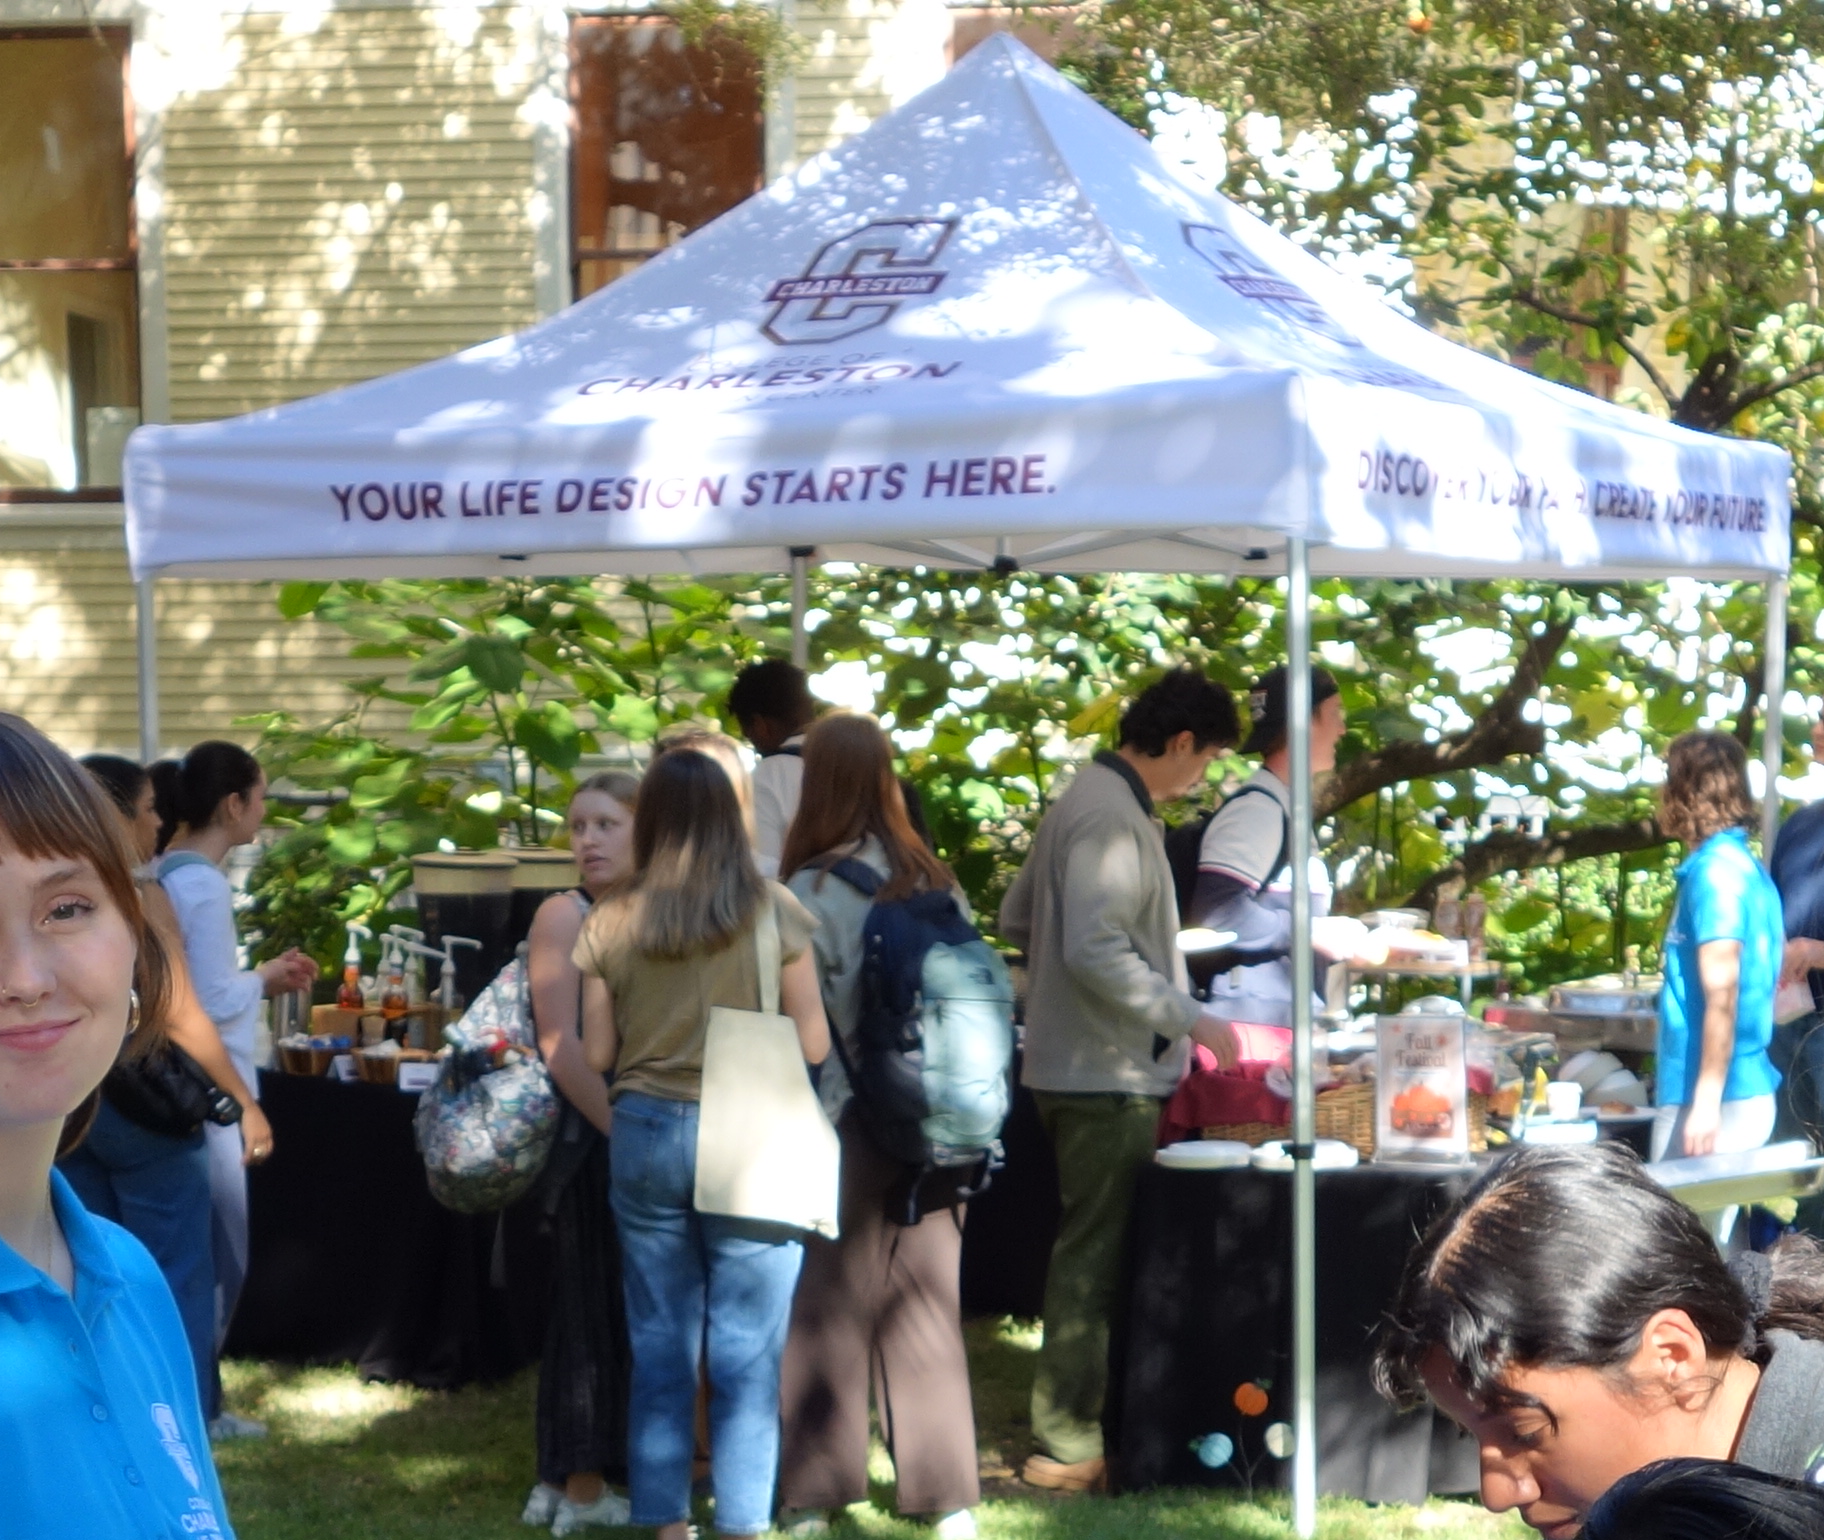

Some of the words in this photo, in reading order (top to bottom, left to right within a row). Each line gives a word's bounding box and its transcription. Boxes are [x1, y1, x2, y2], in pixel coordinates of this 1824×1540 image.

[777, 274, 936, 298] CHARLESTON
[577, 361, 963, 397] CHARLESTON
[687, 354, 831, 372] COLEGE
[840, 352, 885, 365] OF
[329, 481, 446, 521] YOUR
[461, 478, 544, 517] LIFE
[556, 473, 728, 512] DESIGN
[741, 462, 908, 506] STARTS
[923, 454, 1057, 498] HERE.
[1595, 479, 1656, 522] CREATE
